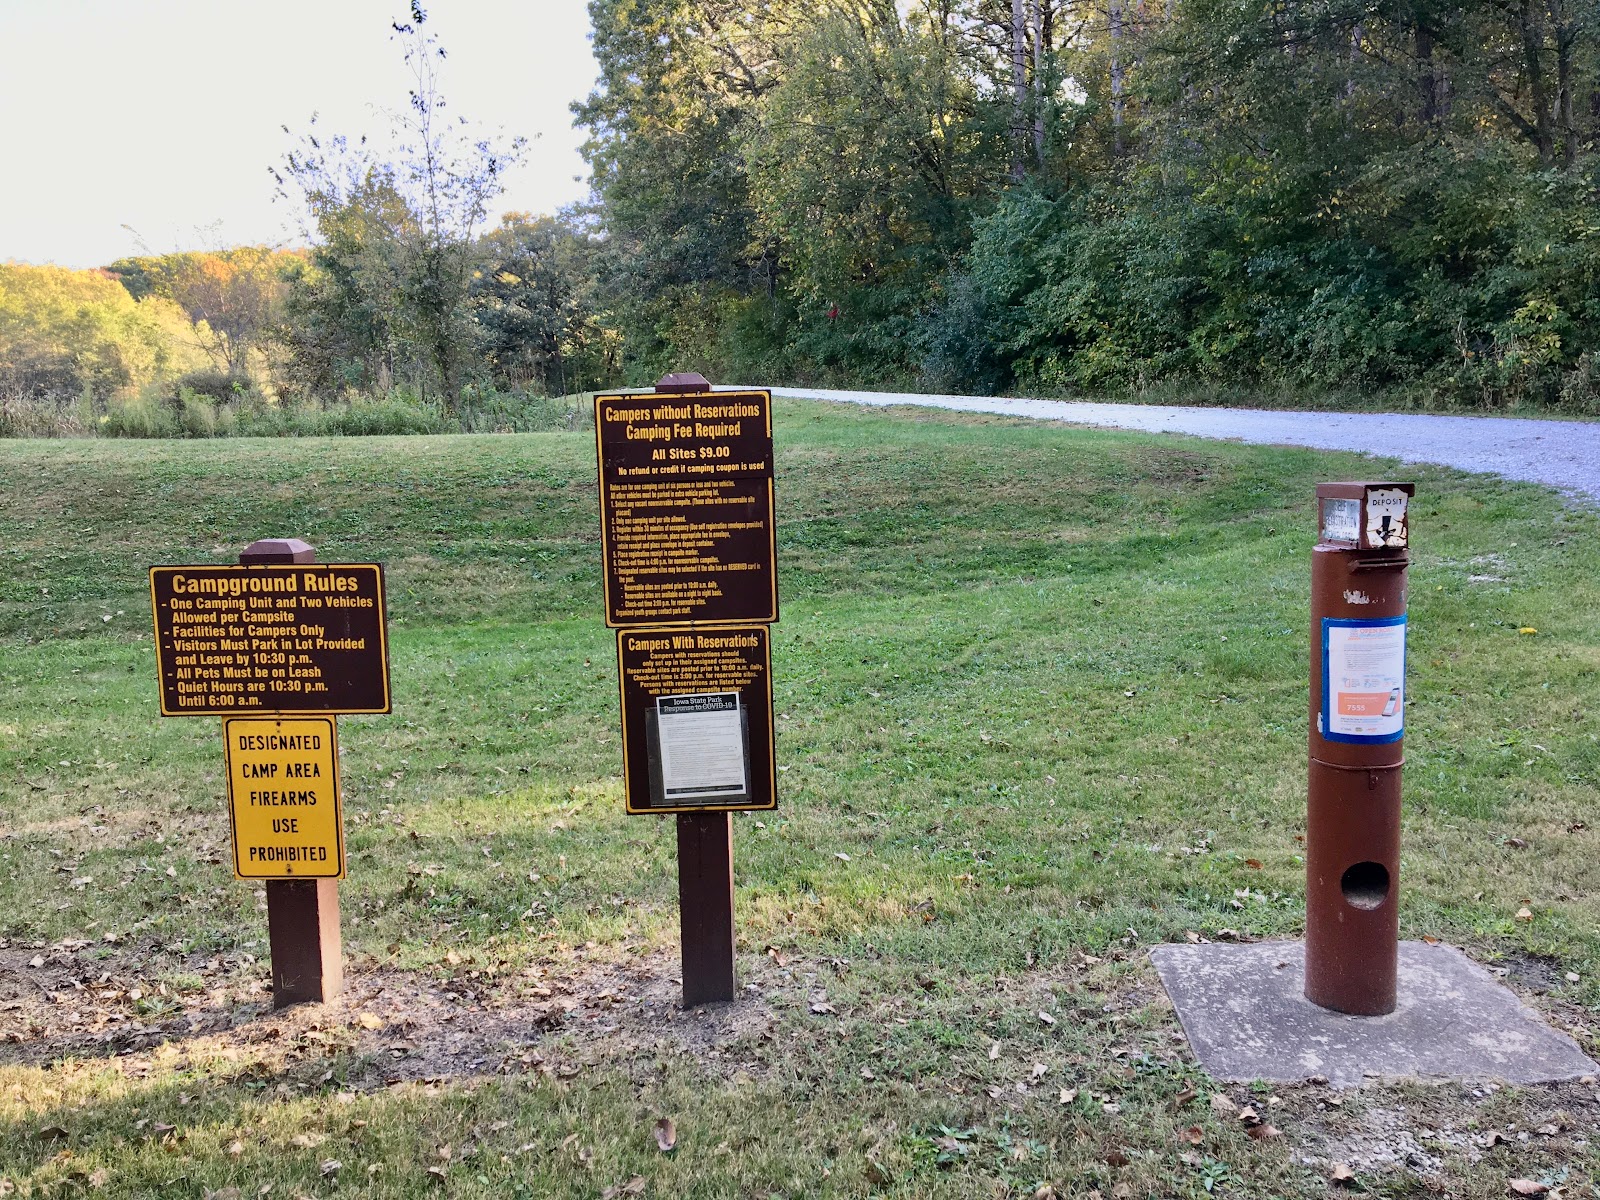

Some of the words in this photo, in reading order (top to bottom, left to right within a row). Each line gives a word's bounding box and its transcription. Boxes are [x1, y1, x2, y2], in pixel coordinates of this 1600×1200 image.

[606, 407, 650, 423] Campers
[653, 405, 691, 420] without
[694, 403, 759, 418] Reservations
[626, 426, 670, 441] Camping
[674, 424, 692, 438] Fee
[696, 422, 741, 439] Required
[652, 449, 666, 460] All
[669, 449, 696, 459] Sites
[699, 446, 730, 458] $9.00
[619, 467, 627, 475] No
[629, 467, 649, 475] refund
[660, 466, 679, 474] credit
[687, 466, 714, 475] camping
[716, 464, 739, 473] coupon
[749, 462, 764, 470] used
[173, 574, 297, 596] Campground
[304, 573, 358, 591] Rules
[170, 598, 192, 609] One
[196, 599, 246, 610] Camping
[250, 597, 273, 608] Unit
[276, 597, 296, 607] and
[299, 597, 321, 607] Two
[324, 596, 373, 607] Vehicles
[173, 611, 216, 623] Allowed
[220, 614, 238, 624] per
[242, 610, 294, 622] Campsite
[173, 625, 225, 637] Facilities
[229, 625, 244, 636] for
[248, 625, 296, 637] Campers
[300, 625, 324, 637] Only
[174, 639, 217, 651] Visitors
[221, 639, 248, 650] Must
[252, 639, 277, 650] Park
[281, 639, 292, 649] in
[295, 639, 313, 649] Lot
[316, 638, 364, 649] Provided
[629, 638, 670, 652] Campers
[672, 636, 694, 649] With
[697, 634, 758, 648] Reservations
[175, 654, 196, 665] and
[200, 654, 233, 664] Leave
[236, 654, 249, 666] by
[252, 653, 285, 664] 10:30
[289, 655, 312, 665] p.m.
[176, 668, 191, 679] All
[195, 668, 220, 678] Pets
[223, 668, 252, 678] Must
[255, 667, 268, 678] be
[272, 669, 285, 677] on
[289, 667, 321, 677] Leash
[178, 682, 207, 693] Quiet
[211, 682, 244, 692] Hours
[247, 683, 265, 692] are
[269, 681, 301, 691] 10:30
[305, 683, 328, 693] p.m.
[179, 695, 205, 706] Until
[209, 695, 234, 706] 6:00
[238, 697, 262, 706] a.m.
[239, 736, 320, 750] DESIGNATED
[243, 764, 277, 778] CAMP
[286, 763, 320, 778] AREA
[250, 791, 317, 805] FIREARMS
[273, 819, 299, 833] USE
[250, 847, 327, 861] PROHIBITED
